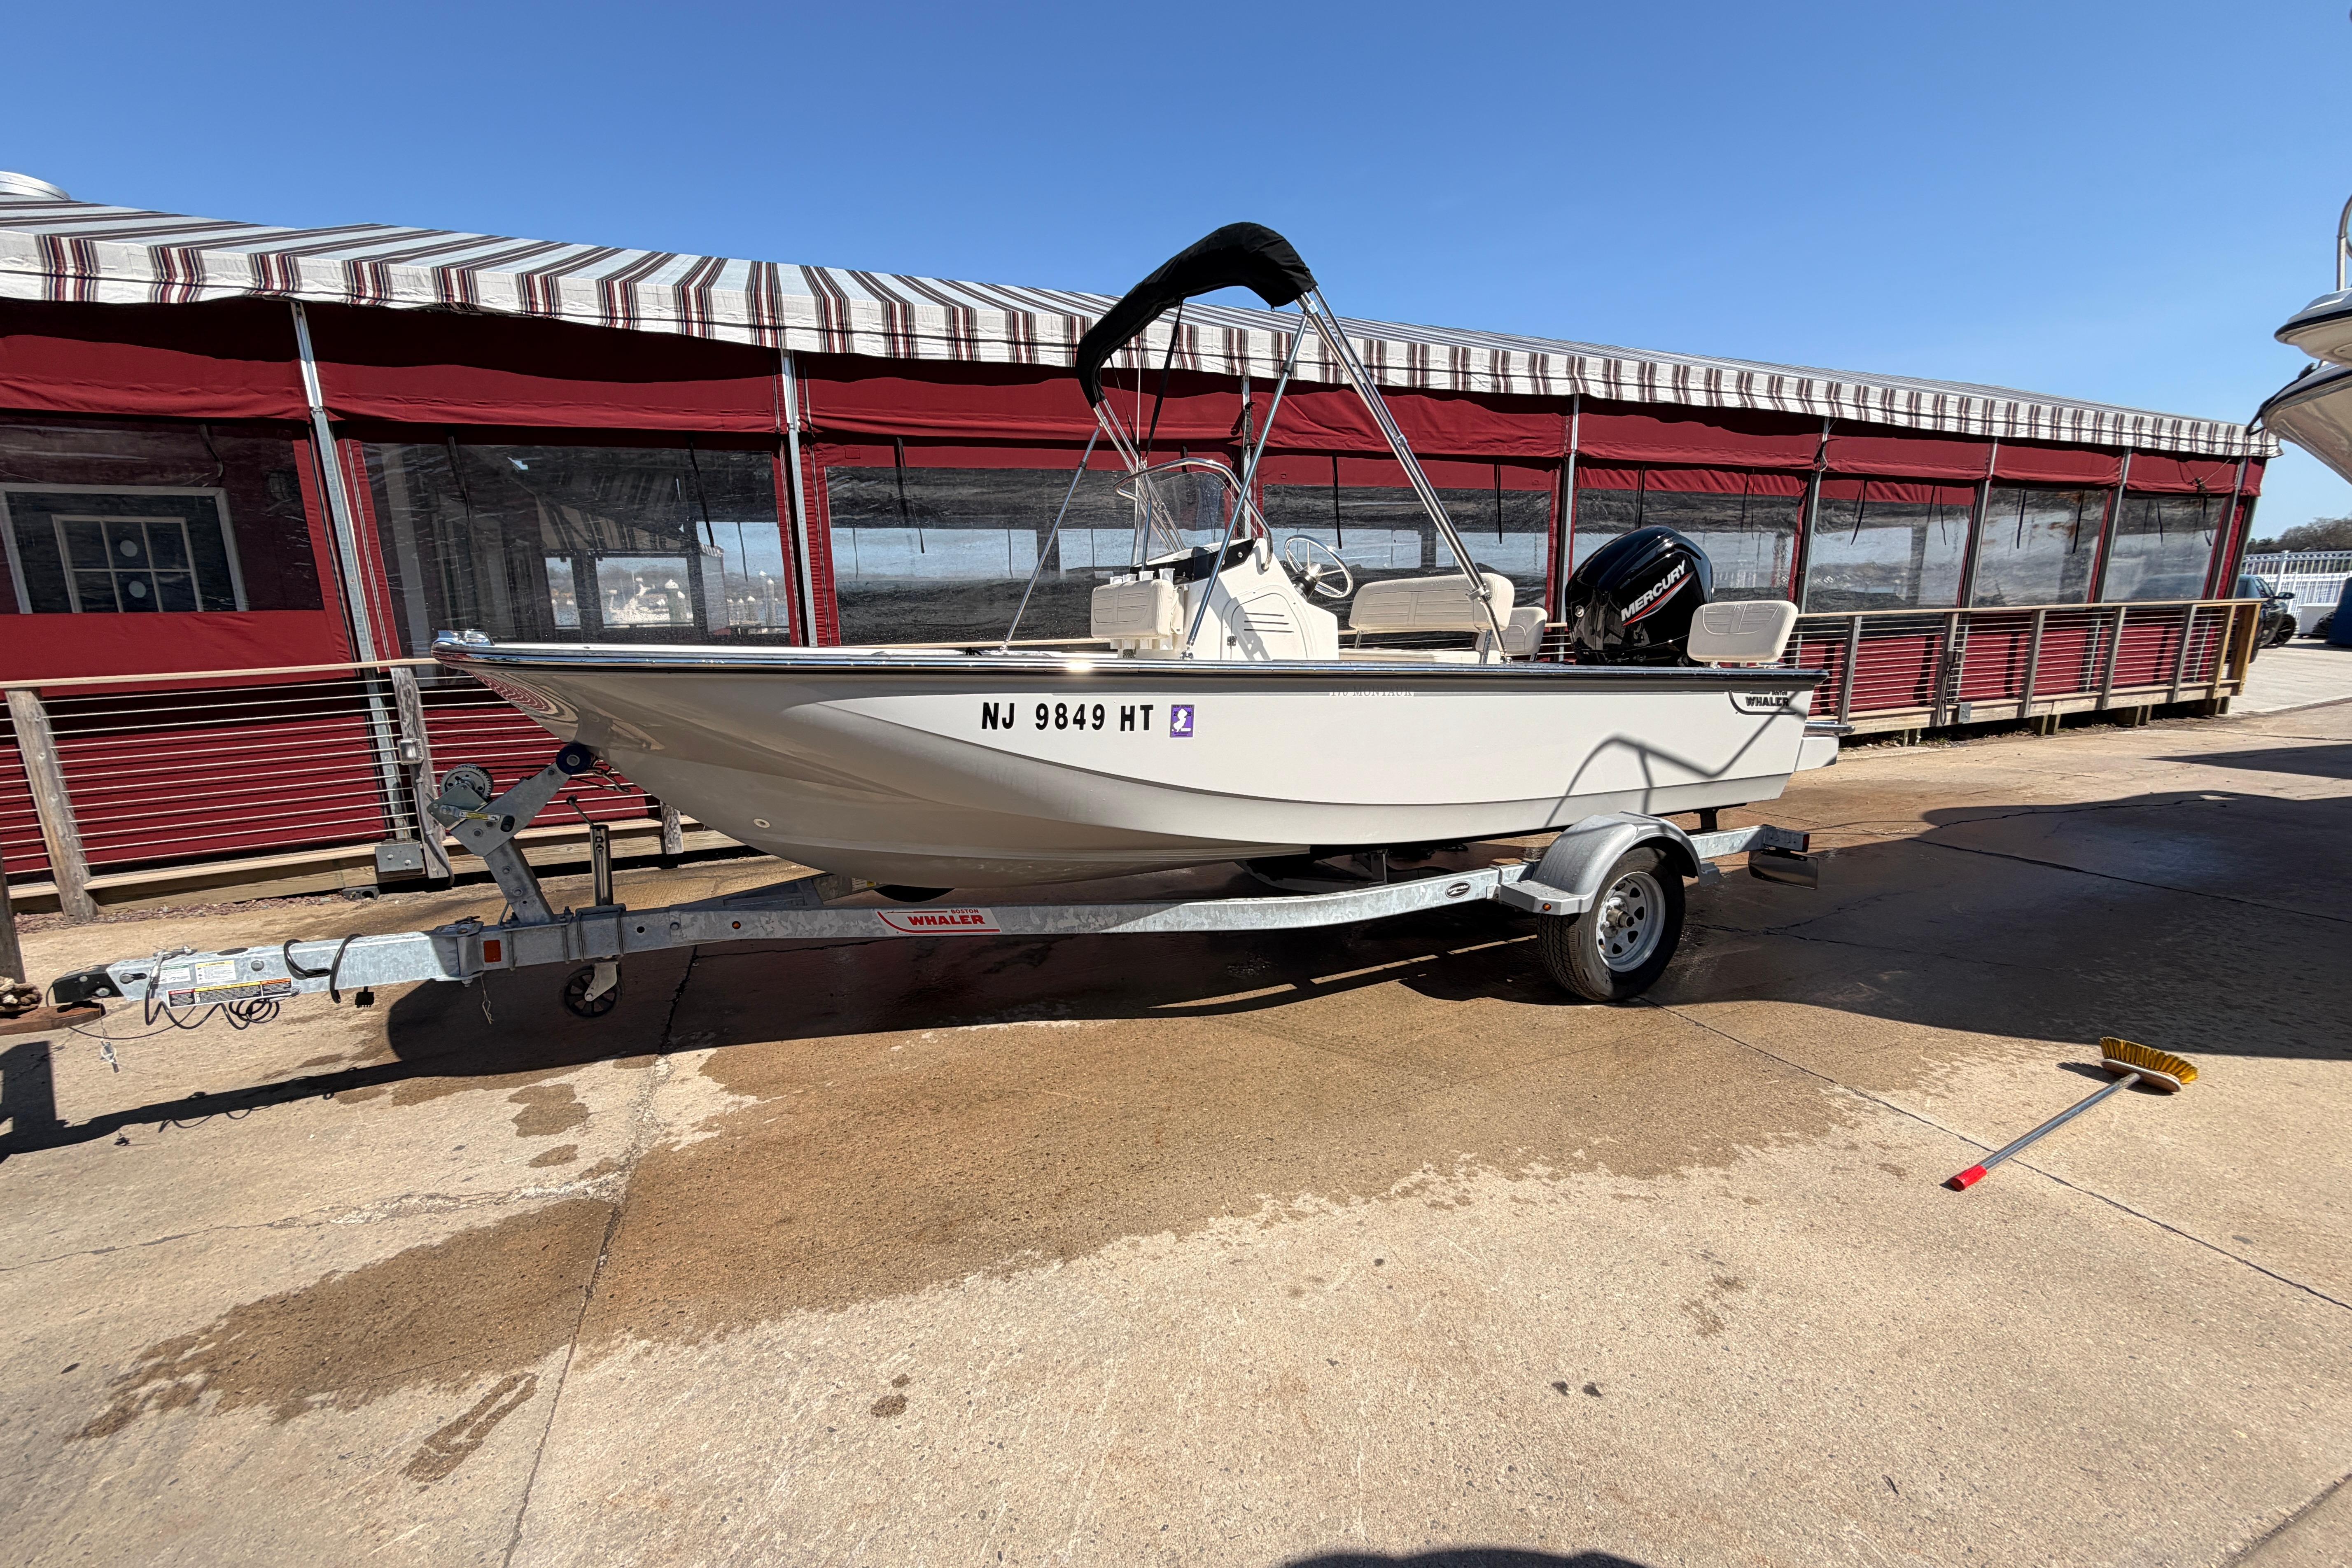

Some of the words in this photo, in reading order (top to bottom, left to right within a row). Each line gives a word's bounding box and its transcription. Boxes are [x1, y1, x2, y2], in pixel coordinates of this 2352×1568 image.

[1621, 560, 1685, 622] MERCURY
[1745, 696, 1789, 707] WHALER
[982, 702, 1015, 730] NJ
[1035, 703, 1105, 730] 9849
[1120, 705, 1153, 731] HT
[907, 915, 985, 925] WHALER
